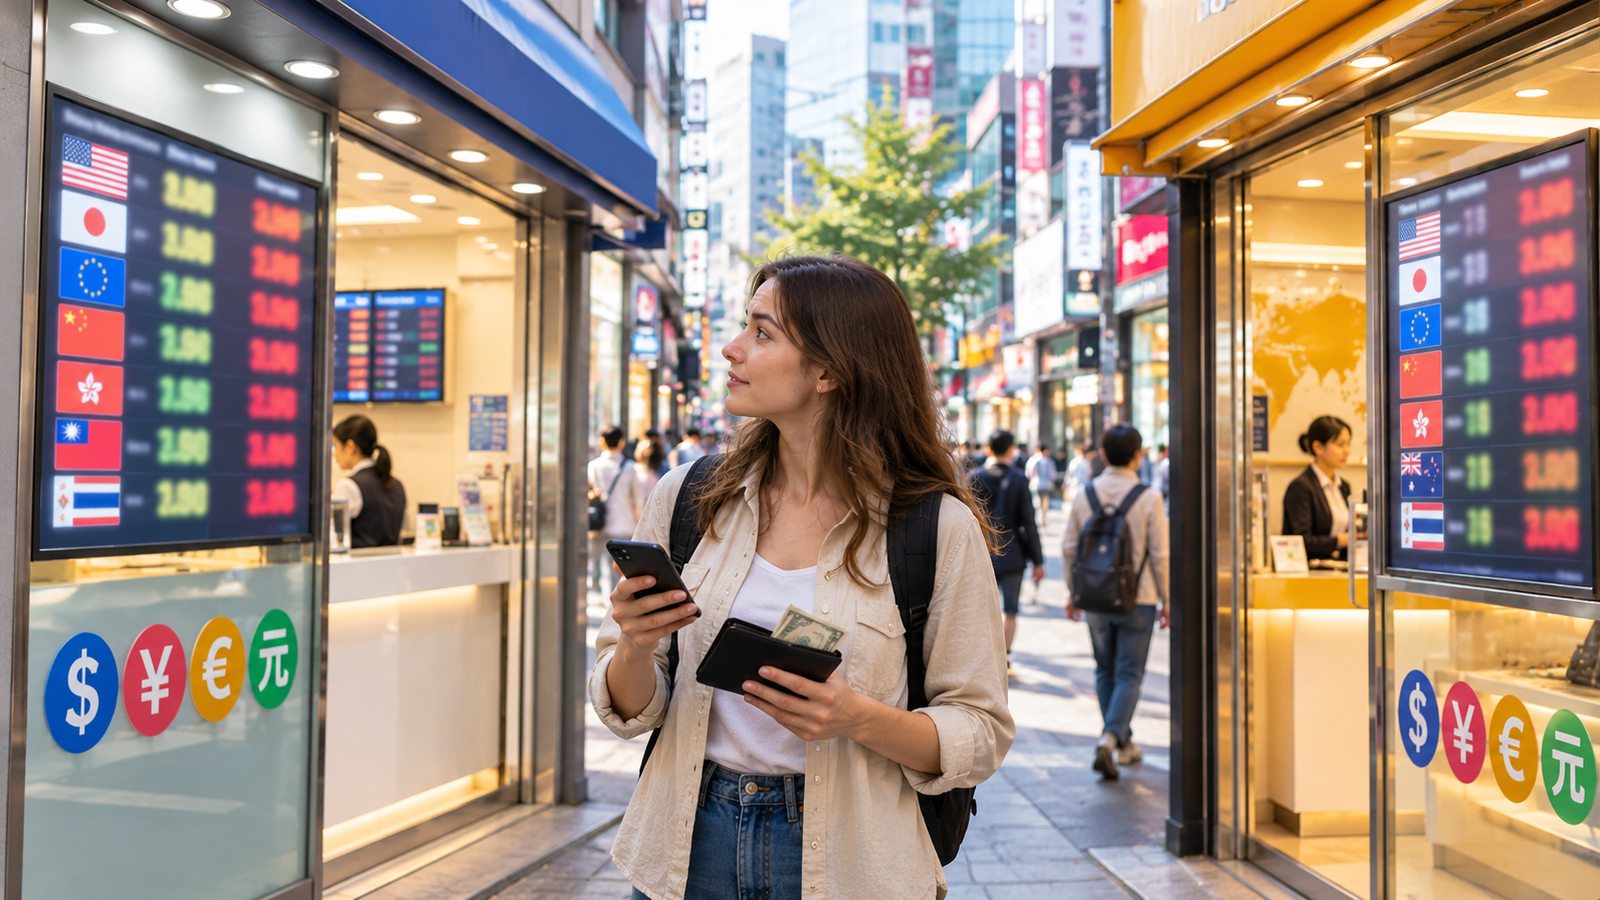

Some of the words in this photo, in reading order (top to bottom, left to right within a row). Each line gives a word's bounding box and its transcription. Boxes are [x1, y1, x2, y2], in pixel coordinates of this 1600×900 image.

[65, 648, 99, 736] $
[139, 645, 173, 715] ¥
[202, 636, 233, 700] €
[258, 628, 289, 692] 元
[1408, 682, 1428, 753] $
[1451, 700, 1475, 764] ¥
[1498, 716, 1525, 782] €
[1551, 730, 1586, 804] 元
